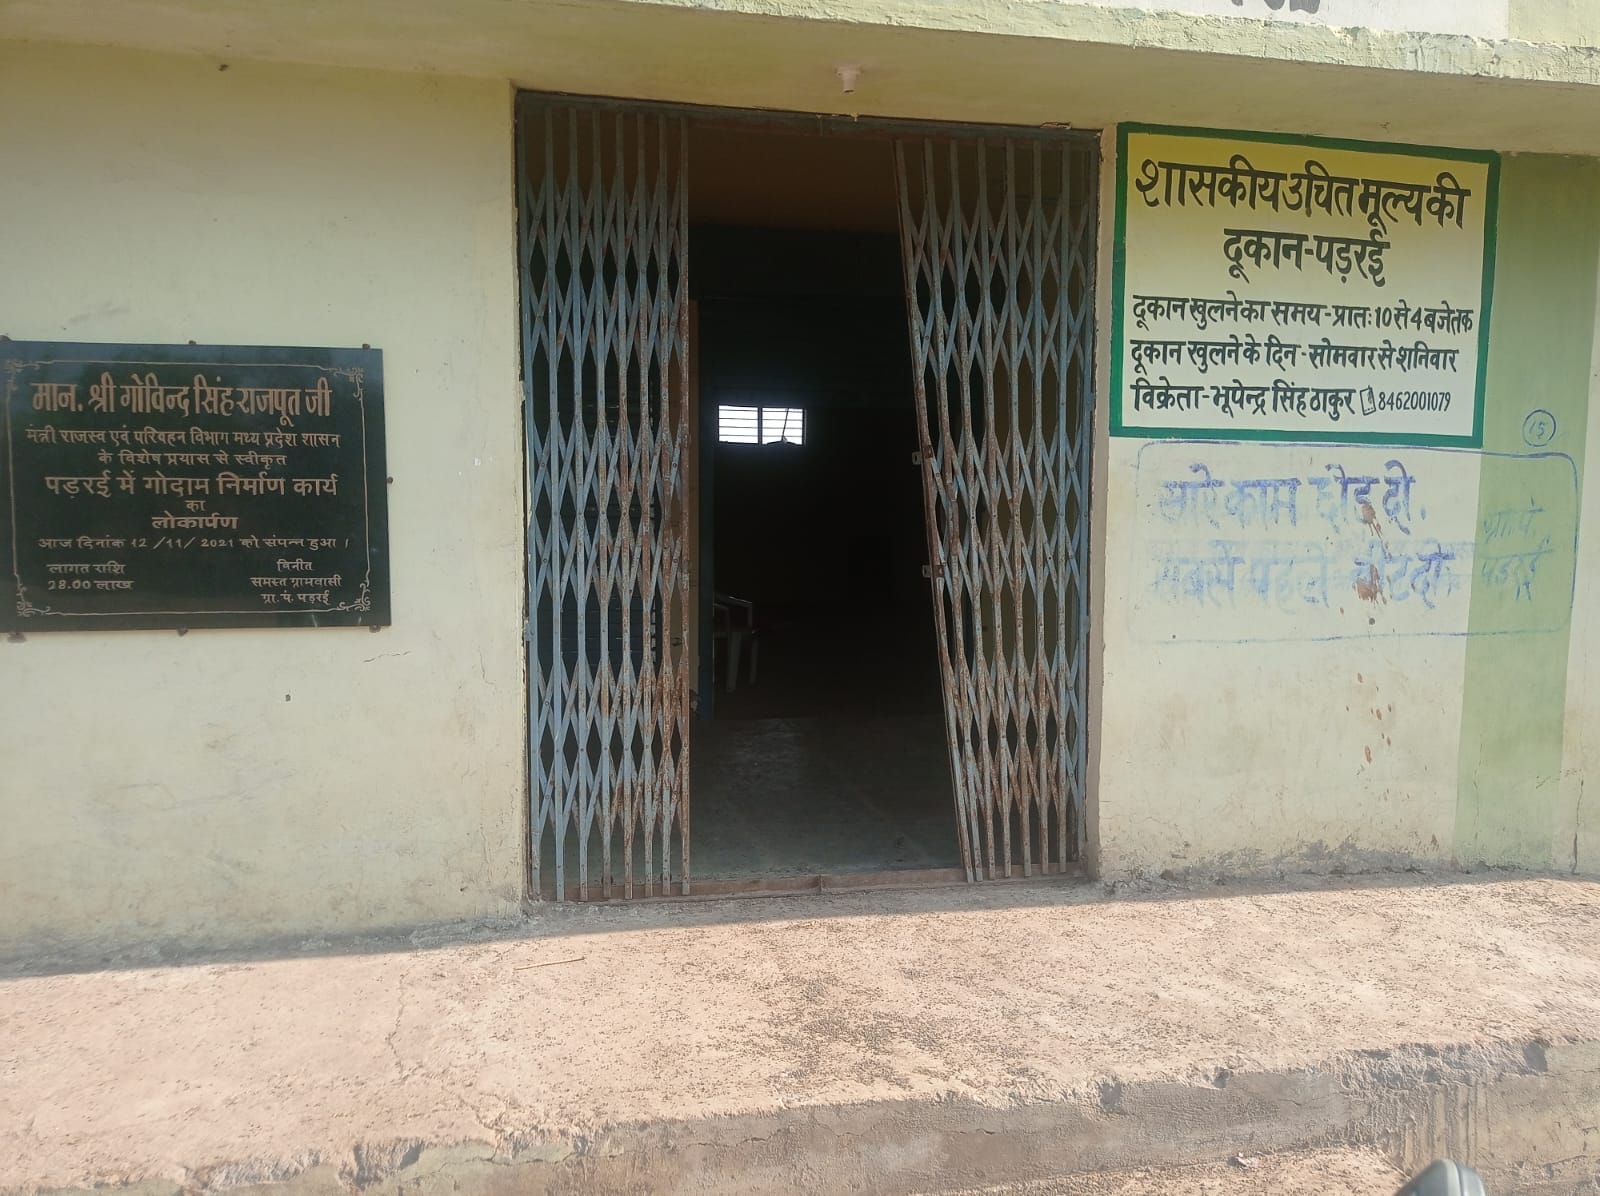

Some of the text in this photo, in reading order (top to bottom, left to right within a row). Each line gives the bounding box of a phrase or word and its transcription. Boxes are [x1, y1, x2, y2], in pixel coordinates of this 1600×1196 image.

[1135, 154, 1471, 235] शासकीय उचित मूल्य की
[1133, 295, 1190, 331] दूकान
[1190, 290, 1243, 330] खुलने
[1240, 300, 1271, 323] का
[1375, 306, 1392, 329] 10
[1394, 299, 1411, 331] से
[1410, 307, 1422, 331] 4
[1424, 300, 1455, 334] बजे
[1130, 340, 1186, 375] दूकान
[1188, 334, 1243, 373] खुलने
[1243, 333, 1262, 366] के
[1377, 339, 1396, 370] से
[1396, 340, 1459, 373] शनिवार
[31, 371, 333, 428] मान. श्री गोविन्द सिंह राजपूत जी
[1272, 379, 1309, 418] सिंह
[1310, 387, 1356, 421] ठाकुर
[1378, 391, 1451, 412] 8462001079
[25, 423, 342, 449] मंत्री राजस्व एवं परिवहन विभाग मध्य प्रदेश शासन
[97, 449, 288, 470] के विशेष प्रयास से स्वीकृत
[44, 469, 339, 499] पड़रई में गोदाम निर्माण कार्य
[184, 500, 206, 512] का
[151, 510, 239, 529] लोकार्पण
[38, 538, 73, 550] आज
[76, 534, 126, 550] दिनांक
[239, 534, 260, 549] को
[262, 534, 305, 548] संपन्न
[307, 538, 337, 551] हुआ
[46, 560, 127, 575] लागत राशि
[276, 558, 313, 572] विनीत
[93, 580, 135, 591] लाख
[249, 574, 343, 588] समस्त ग्रामवासी
